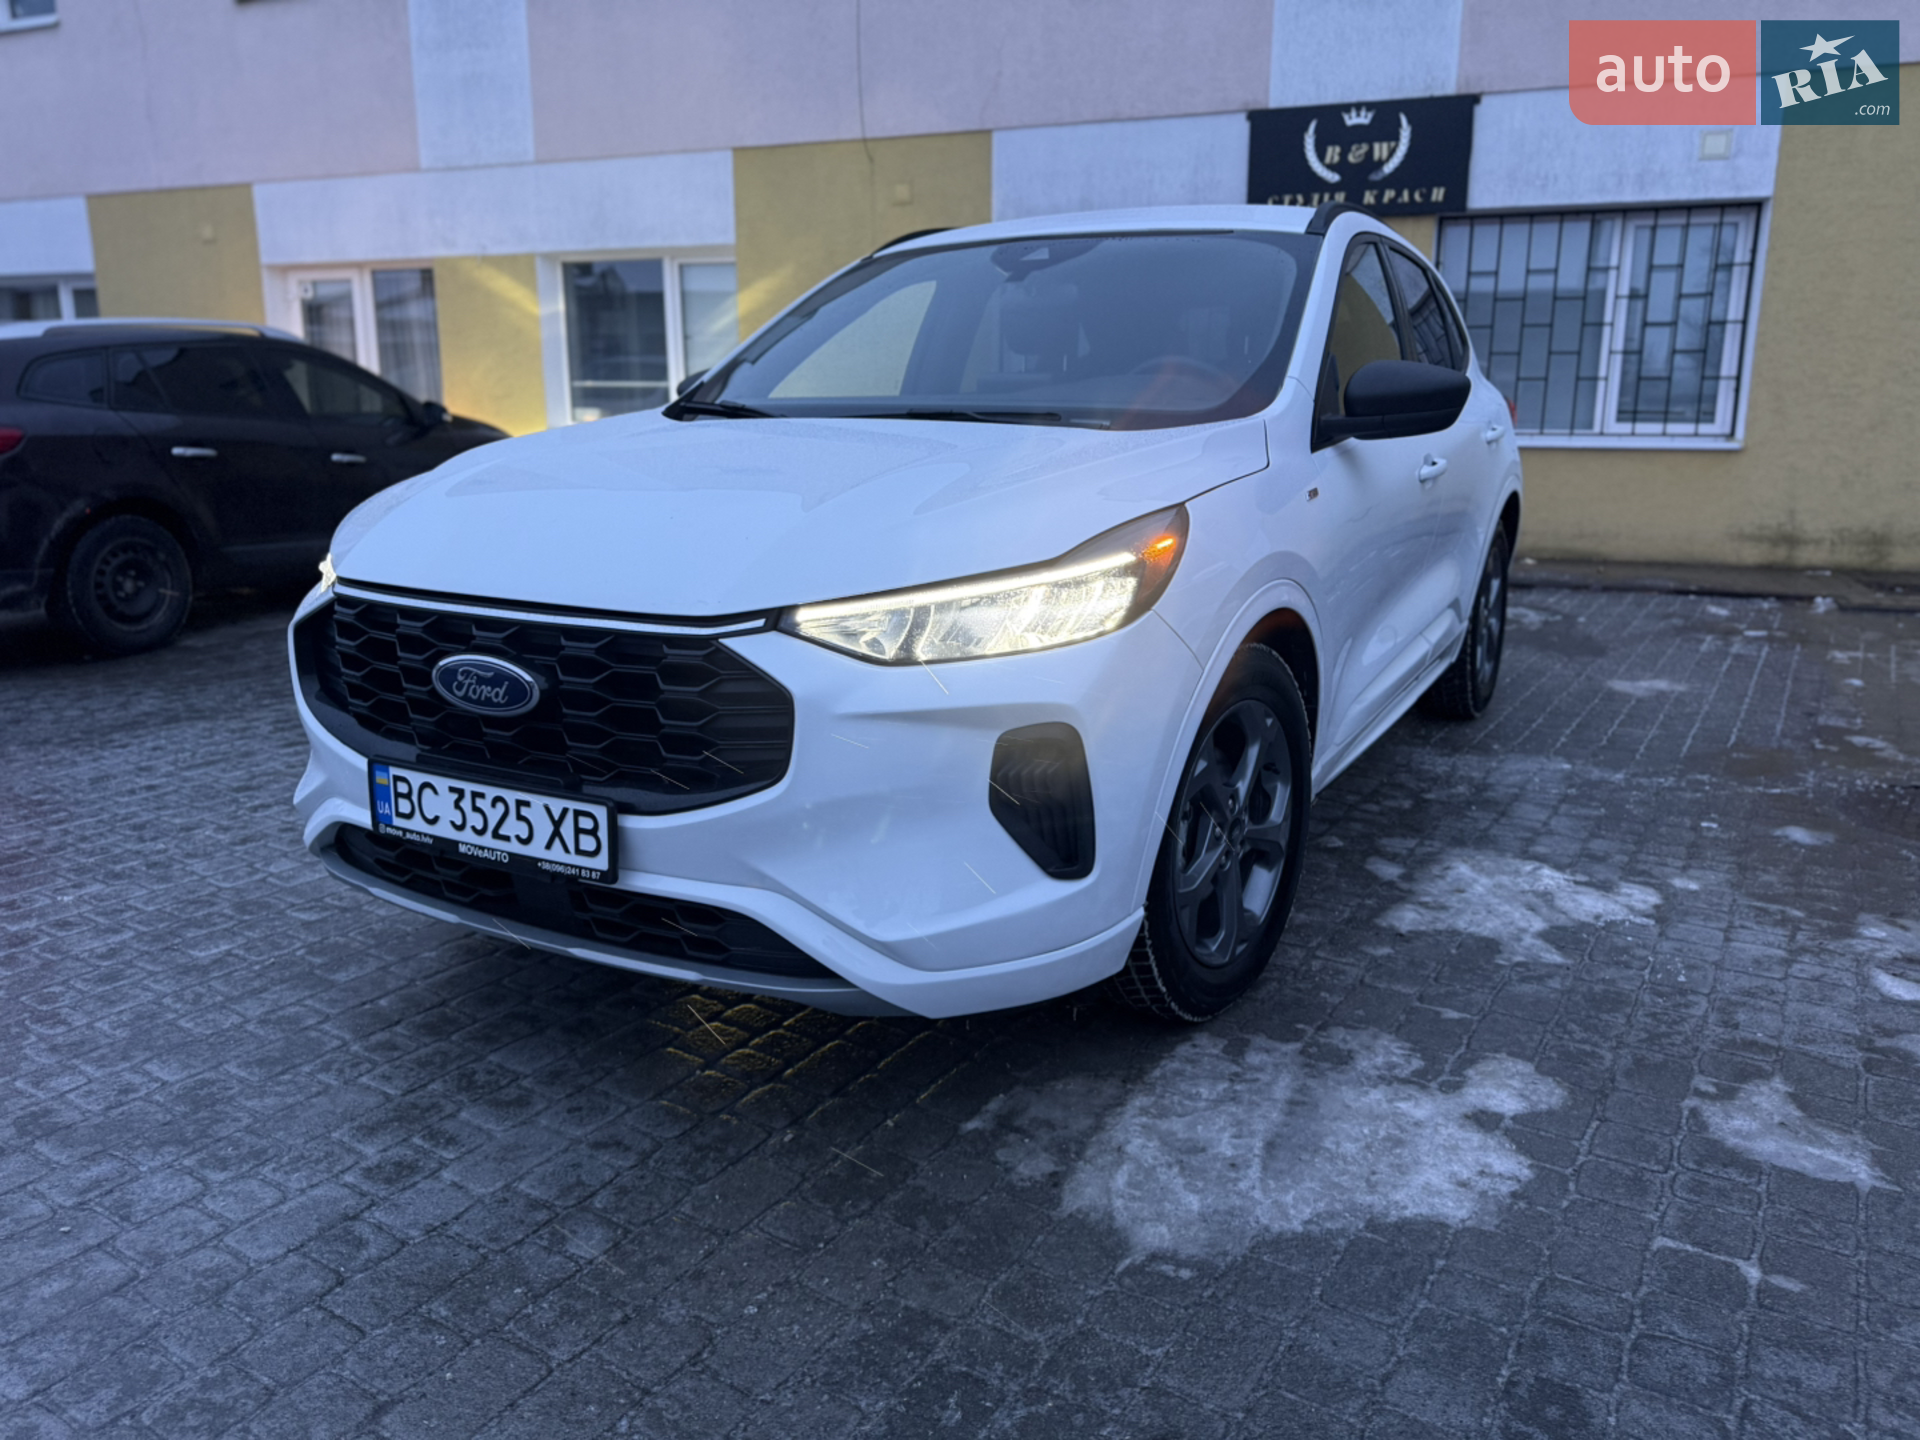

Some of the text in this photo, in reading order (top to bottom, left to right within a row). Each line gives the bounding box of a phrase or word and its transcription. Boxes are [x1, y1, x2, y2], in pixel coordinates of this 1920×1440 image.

[452, 666, 509, 704] Ford
[376, 800, 391, 816] UA
[392, 774, 602, 858] BC 3525 XB
[458, 842, 509, 863] MOVeAUTO
